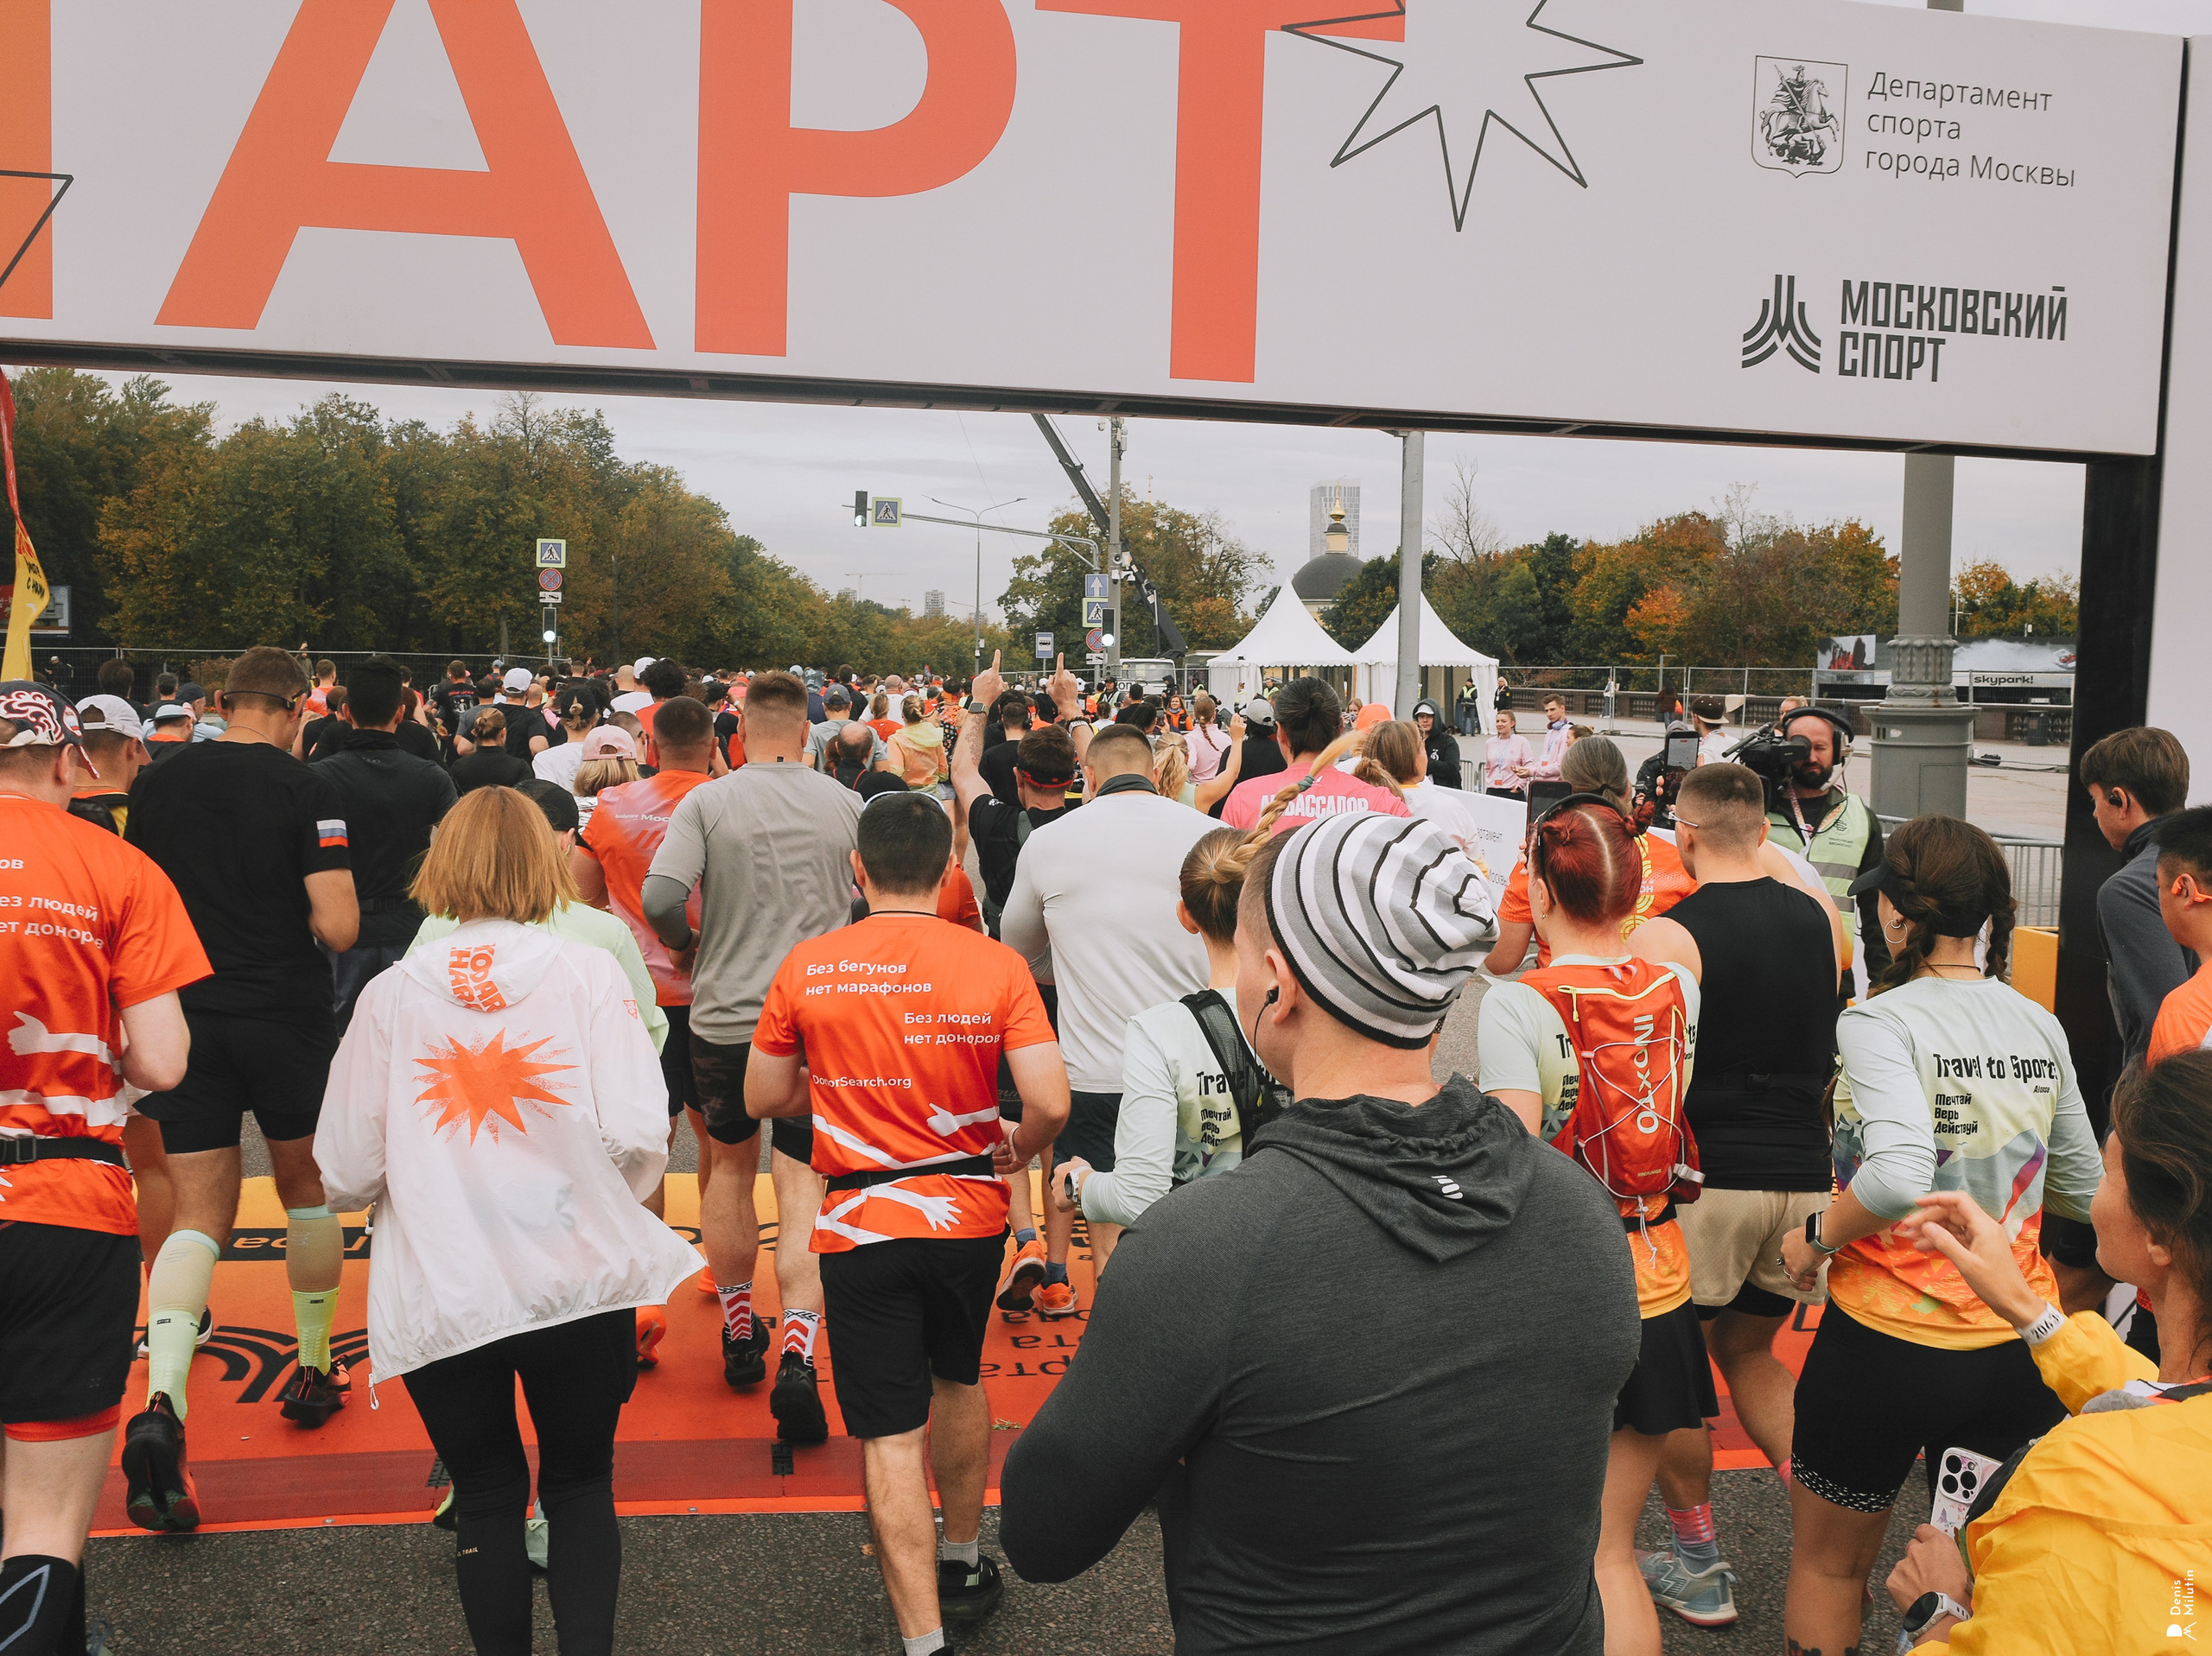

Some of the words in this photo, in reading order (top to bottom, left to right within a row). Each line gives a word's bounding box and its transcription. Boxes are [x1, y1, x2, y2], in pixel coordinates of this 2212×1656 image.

[1867, 72, 2052, 111] Департамент
[1867, 113, 1961, 143] спорта
[1866, 150, 1959, 181] города
[1970, 155, 2075, 187] Москвы
[1840, 279, 2067, 340] МОСКОВСКИЙ
[1839, 331, 1946, 382] СПОРТ
[1974, 675, 2034, 686] skypark!
[29, 897, 98, 922] людей
[24, 923, 104, 949] донорв
[806, 962, 835, 976] Без
[838, 959, 907, 974] бегунов
[805, 983, 832, 995] нет
[836, 981, 931, 996] марафонов
[904, 1012, 932, 1025] Без
[937, 1012, 992, 1025] людей
[904, 1033, 931, 1044] нет
[936, 1033, 1001, 1045] доноров
[1986, 1056, 2005, 1079] to
[812, 1075, 912, 1088] DonorSearch.org
[1935, 1093, 1972, 1106] Мечтай
[1200, 1107, 1232, 1121] Мечтай
[1934, 1107, 1959, 1121] Верь
[1934, 1120, 1978, 1135] Действуй
